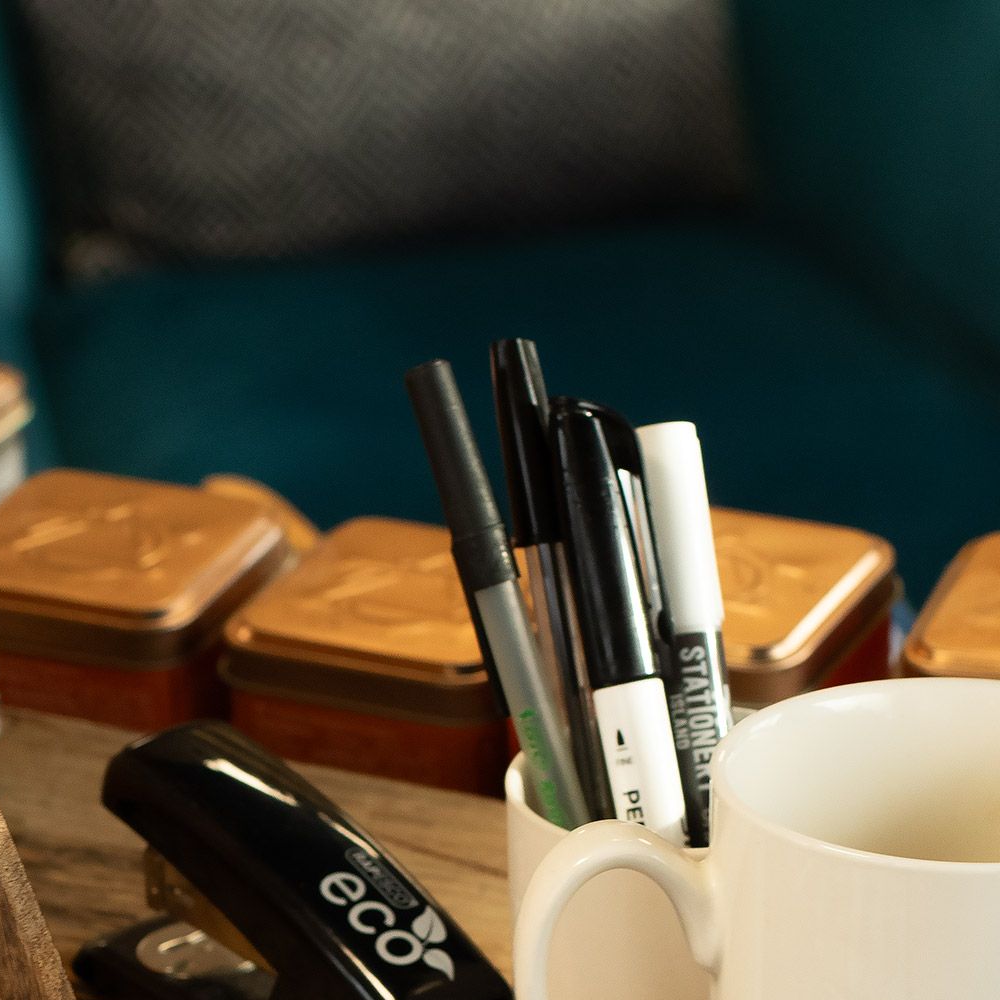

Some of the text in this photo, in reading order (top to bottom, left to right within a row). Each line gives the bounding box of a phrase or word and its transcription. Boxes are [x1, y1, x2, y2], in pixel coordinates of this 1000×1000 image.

[669, 694, 691, 750] ISLAND
[624, 790, 645, 826] PE
[319, 871, 424, 966] eco
